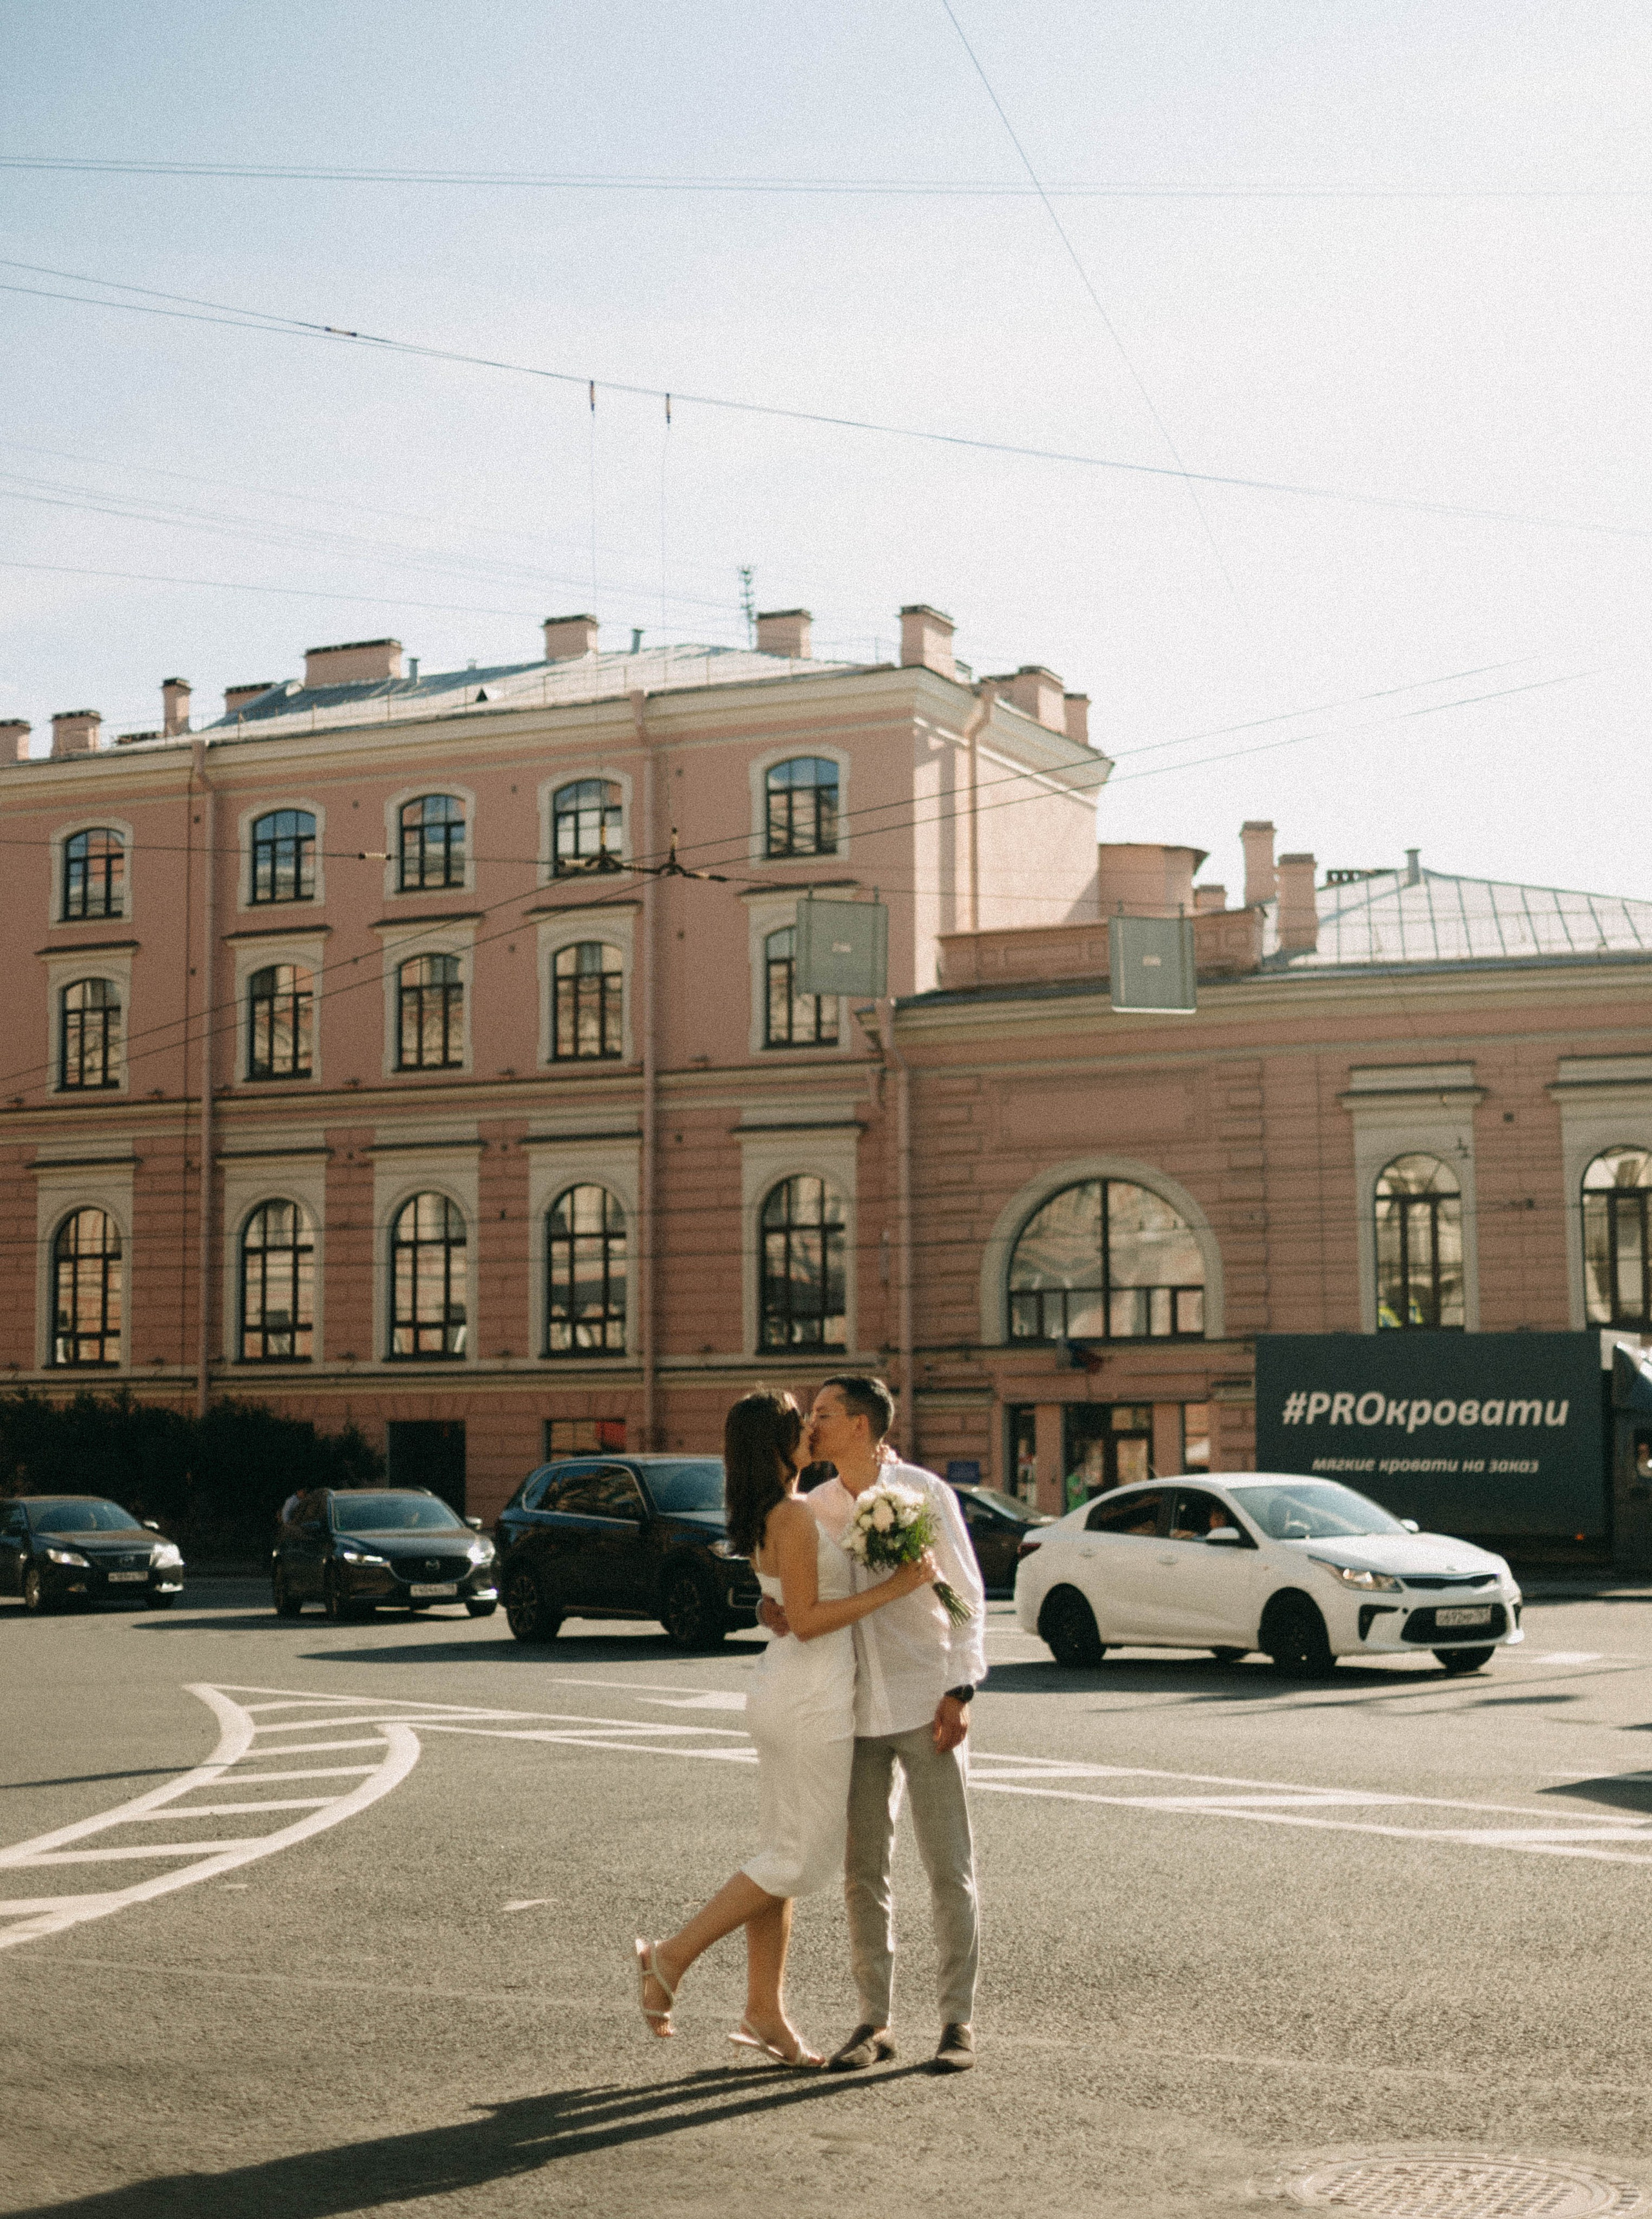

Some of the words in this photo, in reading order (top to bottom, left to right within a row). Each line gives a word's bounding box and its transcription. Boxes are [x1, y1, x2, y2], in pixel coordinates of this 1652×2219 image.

[1282, 1391, 1569, 1434] #PROкровати
[1312, 1458, 1376, 1471] мягкие
[1378, 1458, 1458, 1475] кровати
[1462, 1459, 1486, 1472] на
[1489, 1459, 1539, 1473] заказ
